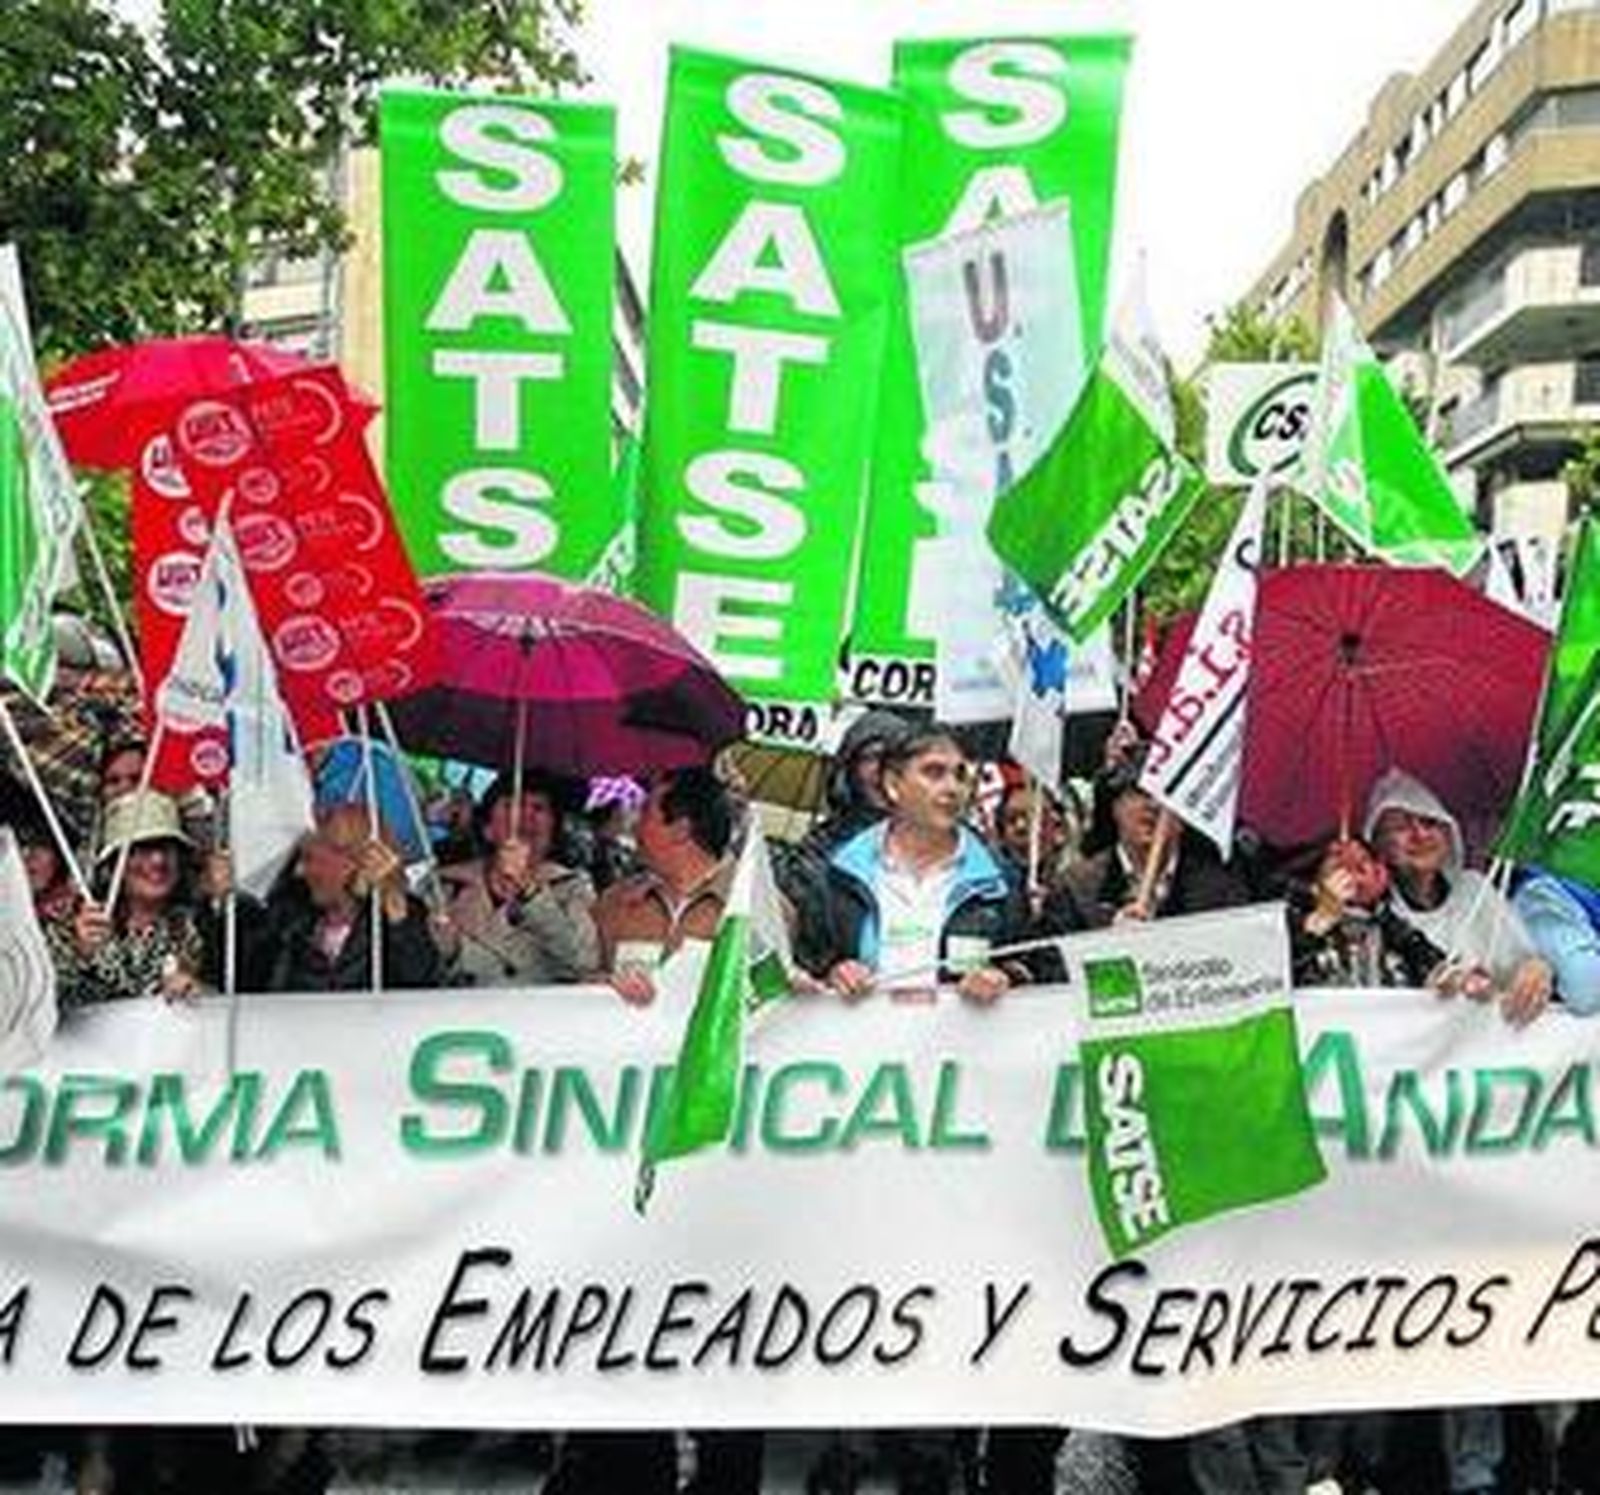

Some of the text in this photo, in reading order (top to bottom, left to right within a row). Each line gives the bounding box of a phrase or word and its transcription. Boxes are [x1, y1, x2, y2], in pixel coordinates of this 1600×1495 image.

[672, 74, 848, 682] SATSE
[1253, 403, 1308, 441] CS
[852, 659, 935, 700] COR
[1099, 1052, 1170, 1241] SATSE
[67, 1283, 194, 1371] DE
[212, 1289, 389, 1371] LOS
[420, 1247, 935, 1376] EMPLEADOS
[972, 1283, 1031, 1365] Y
[1059, 1259, 1510, 1378] SERVICIOS
[1526, 1237, 1600, 1343] P
